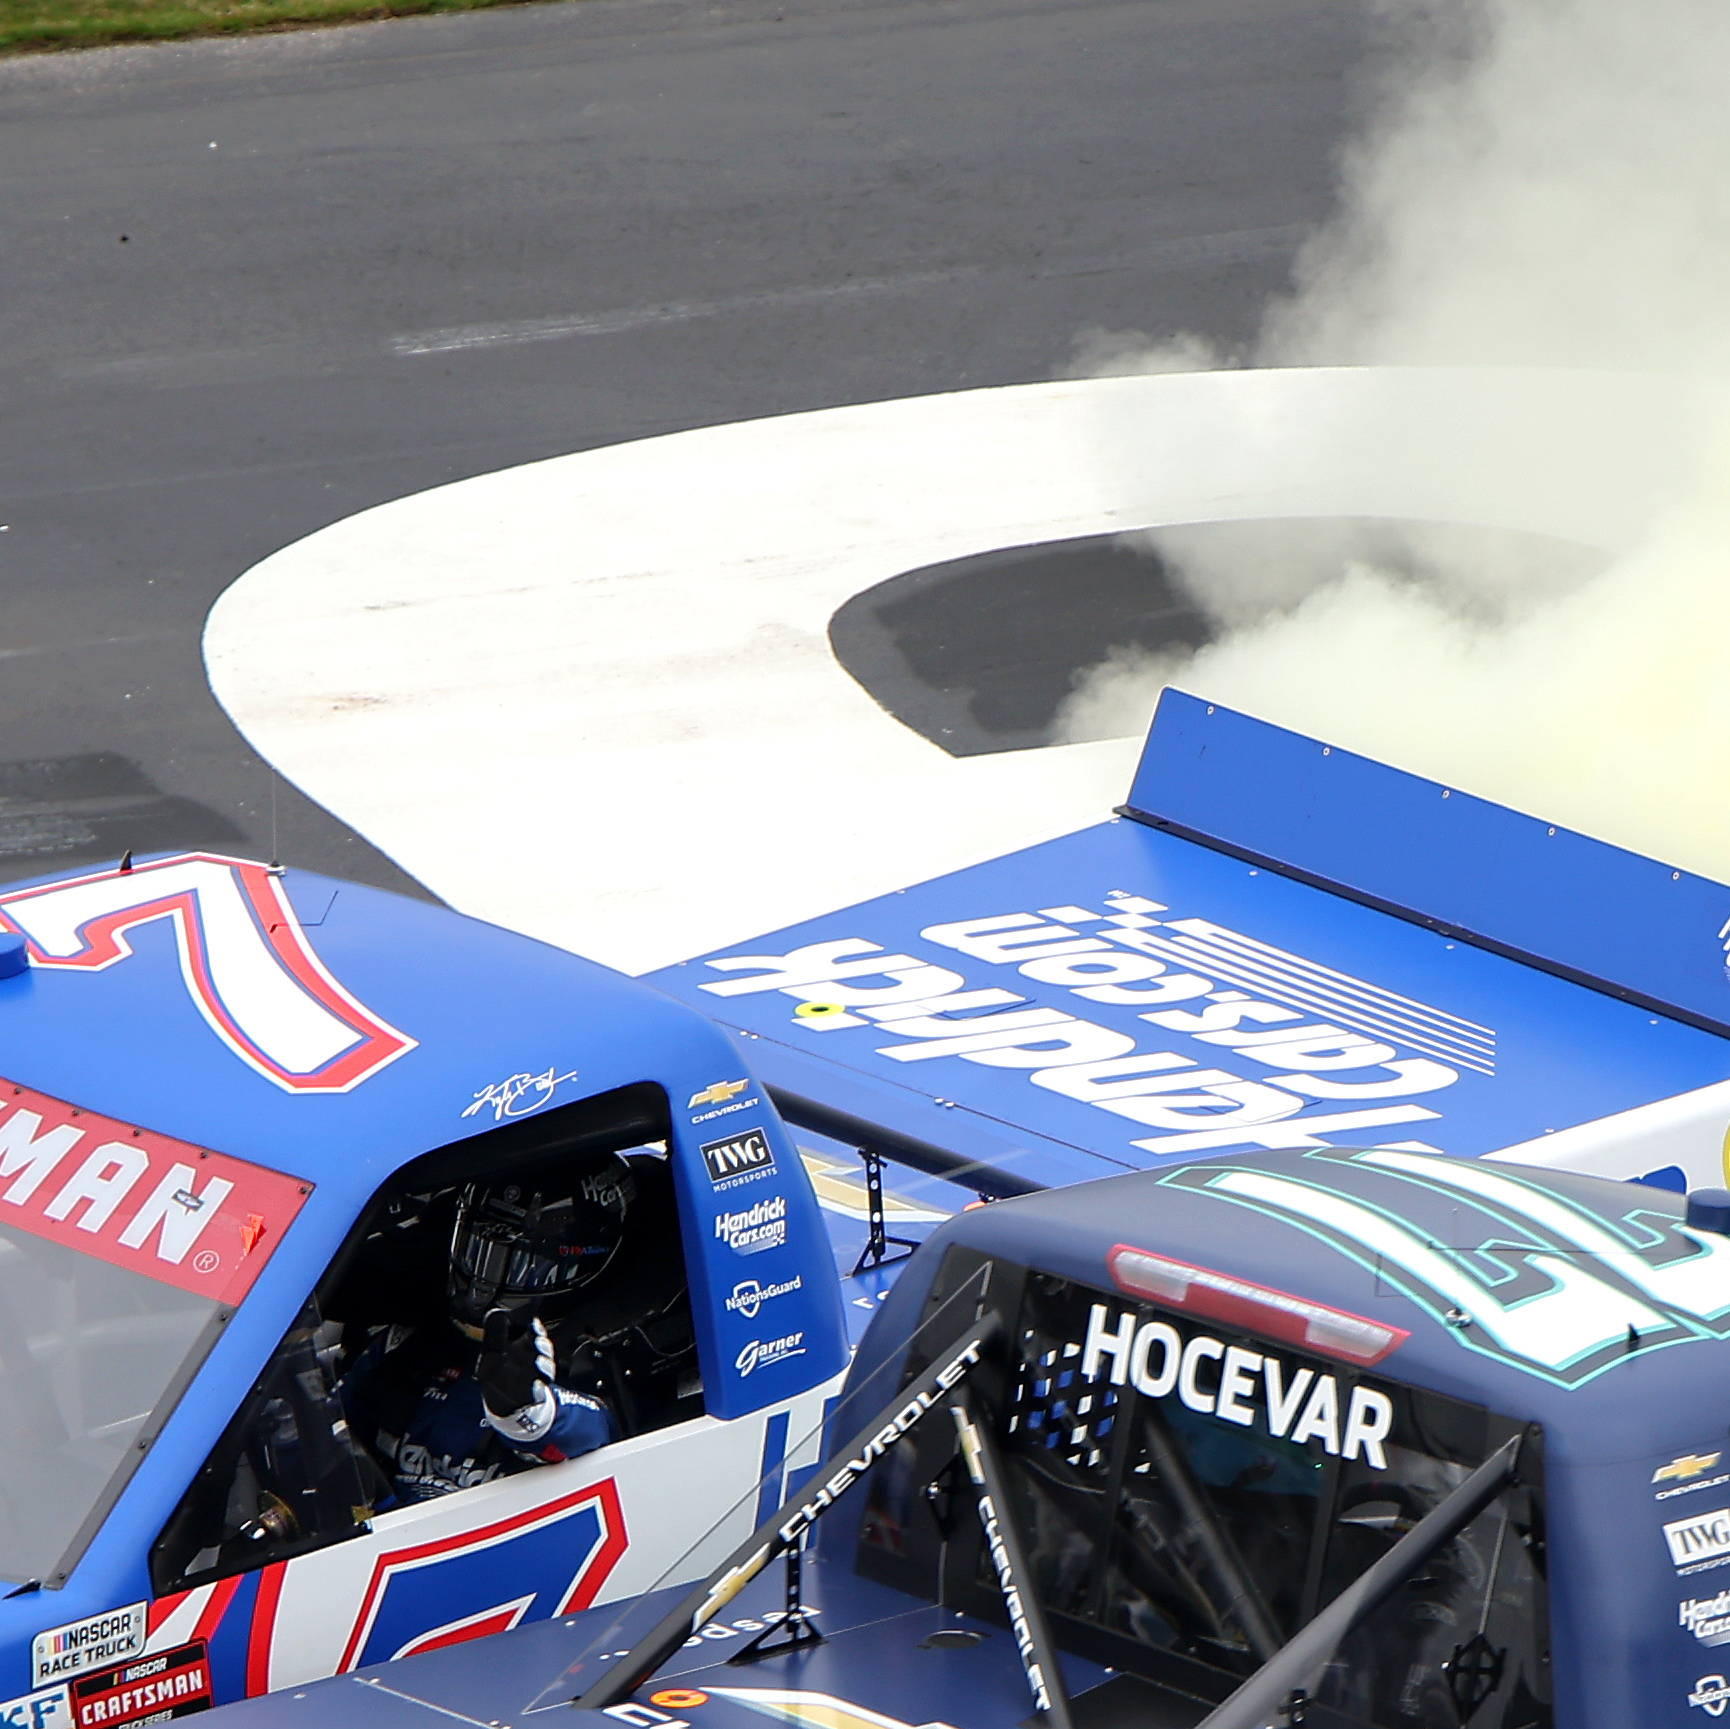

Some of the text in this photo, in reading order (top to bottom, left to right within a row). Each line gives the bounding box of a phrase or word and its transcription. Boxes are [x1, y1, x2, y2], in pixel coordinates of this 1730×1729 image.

[920, 904, 1460, 1100] Cars.com
[692, 1098, 759, 1124] CHEVROLET
[707, 1135, 769, 1175] TWG
[713, 1167, 778, 1193] MOTORSPORTS
[715, 1197, 786, 1240] Hendrick
[730, 1218, 786, 1249] Cars.com
[725, 1276, 802, 1311] NationsGuard
[735, 1331, 804, 1377] Garner
[1081, 1303, 1393, 1472] HOCEVAR
[779, 1340, 982, 1544] CHEVROLET
[978, 1494, 1052, 1713] CHEVROLET
[68, 1613, 132, 1648] NASCAR
[39, 1634, 137, 1678] RACE TRUCK
[125, 1657, 168, 1682] NASCAR
[81, 1668, 204, 1725] CRAFTSMAN
